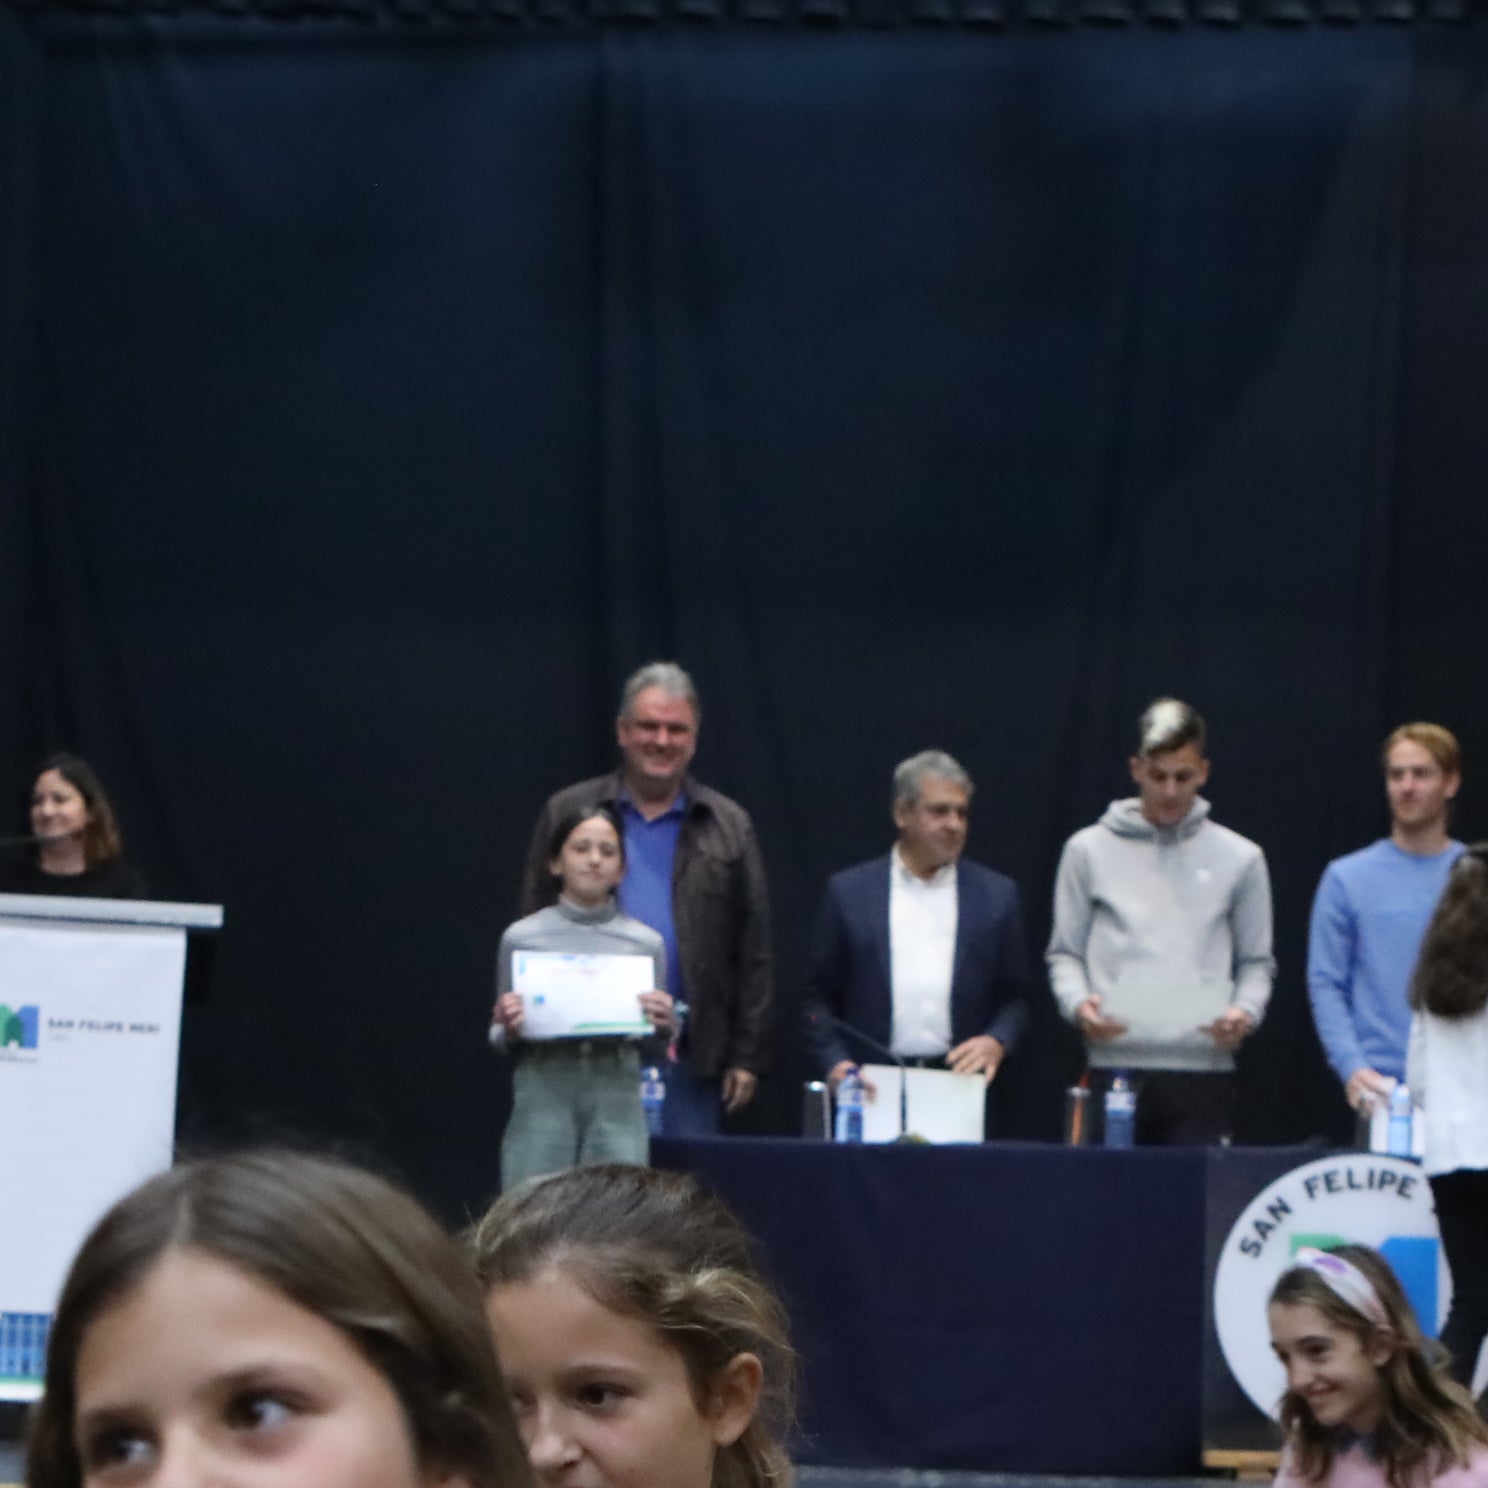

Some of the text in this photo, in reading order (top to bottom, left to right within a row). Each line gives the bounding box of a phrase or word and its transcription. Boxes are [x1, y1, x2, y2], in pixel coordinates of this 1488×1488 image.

[48, 1018, 75, 1029] SAN
[78, 1019, 124, 1032] FELIPE
[1240, 1167, 1418, 1258] SAN FELIPE
